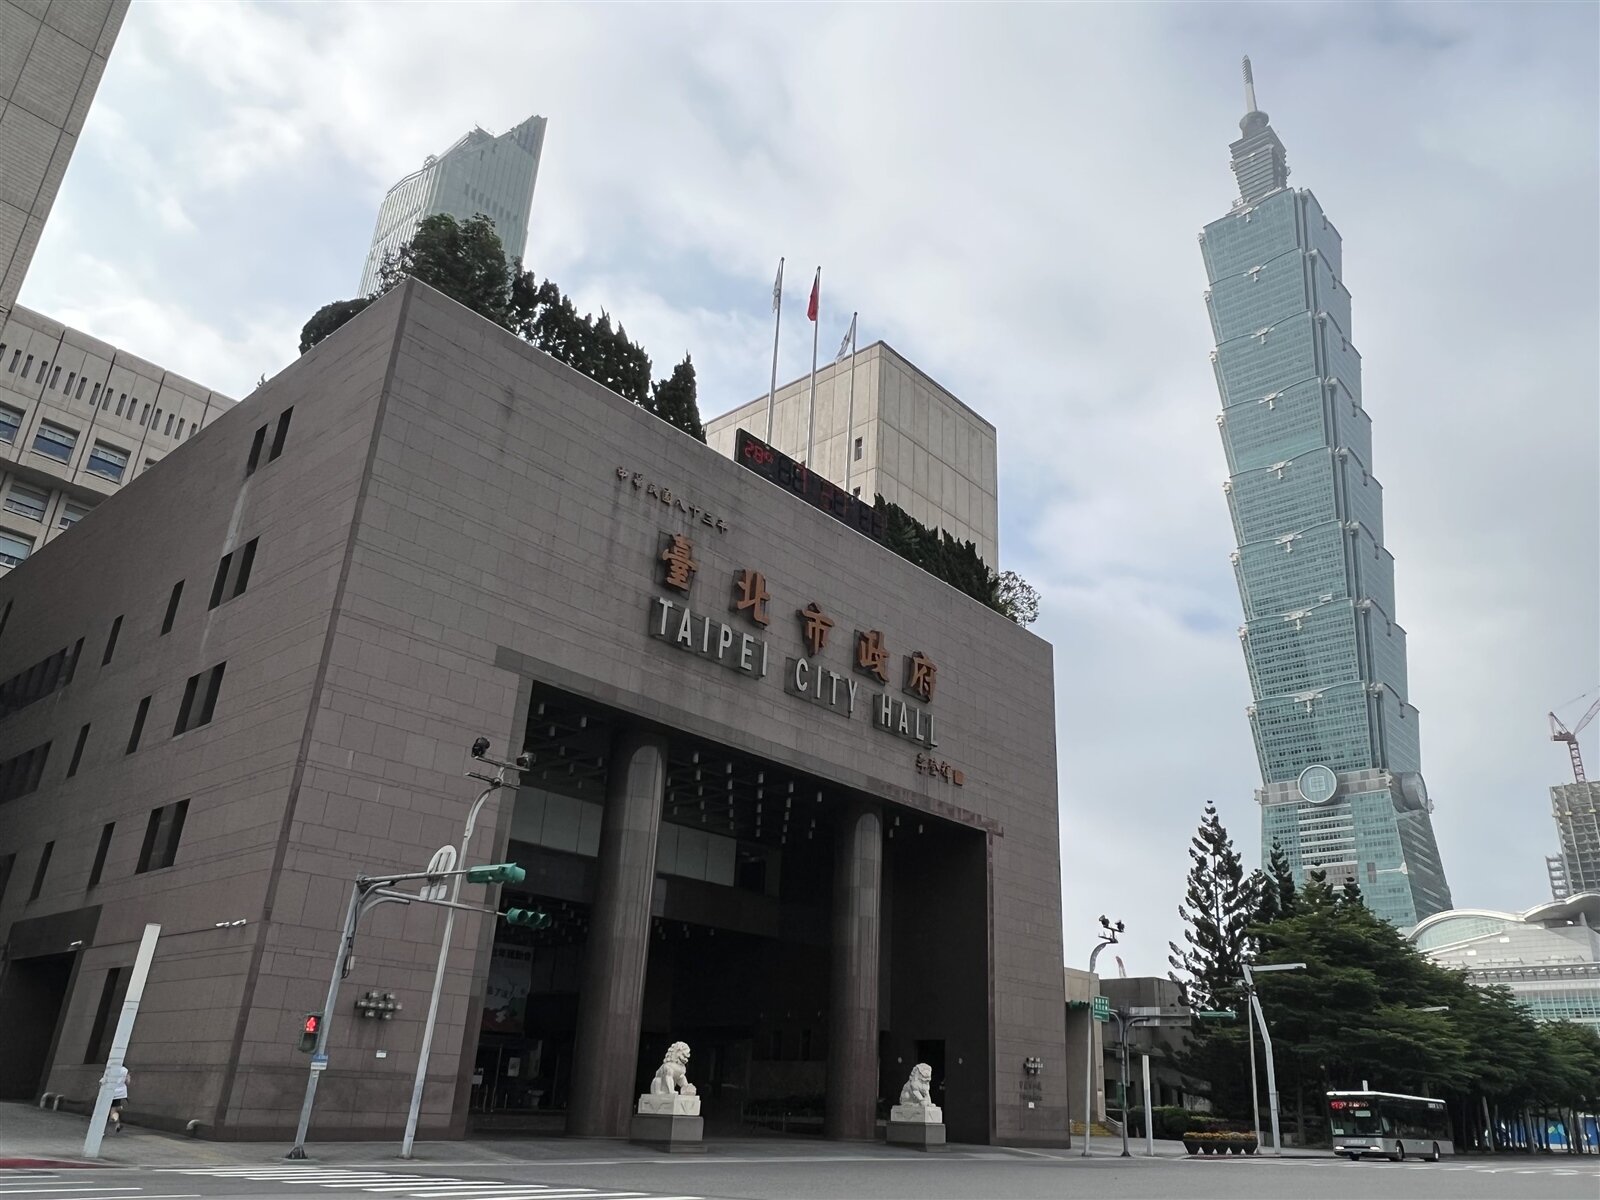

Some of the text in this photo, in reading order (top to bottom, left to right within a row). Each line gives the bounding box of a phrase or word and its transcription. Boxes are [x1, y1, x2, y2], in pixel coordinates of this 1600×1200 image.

[659, 597, 938, 746] TAIPEI CITY HALL
[662, 532, 937, 703] 臺北市政府
